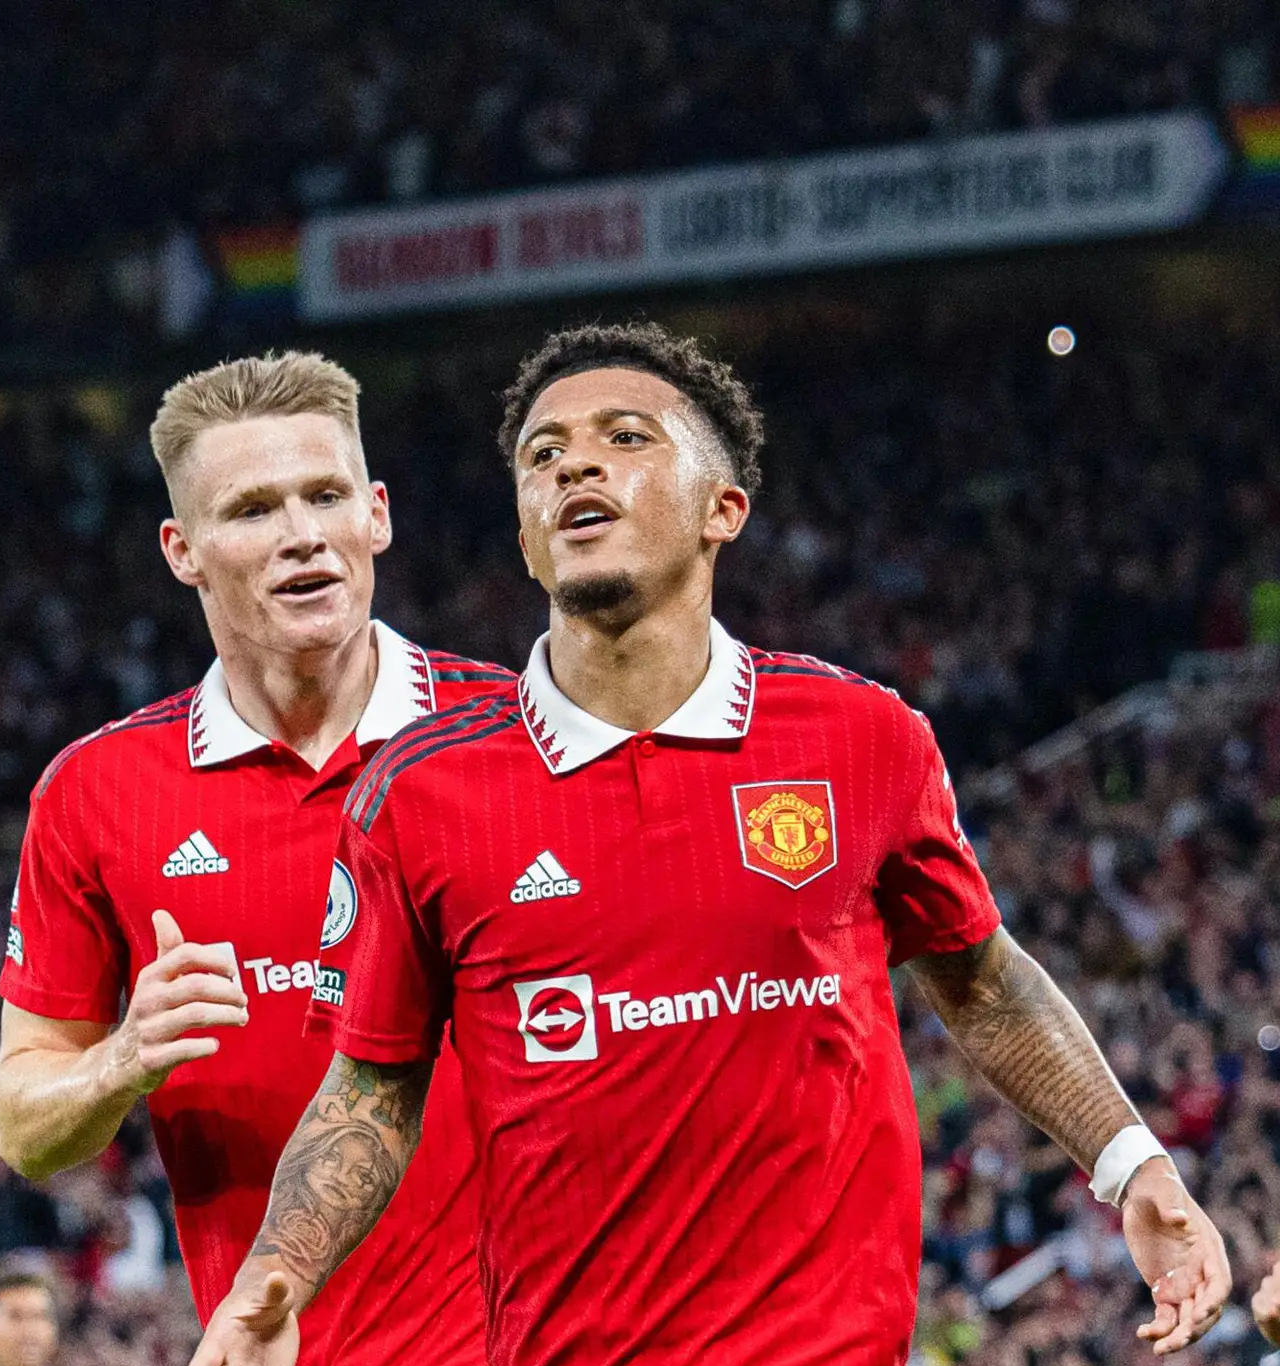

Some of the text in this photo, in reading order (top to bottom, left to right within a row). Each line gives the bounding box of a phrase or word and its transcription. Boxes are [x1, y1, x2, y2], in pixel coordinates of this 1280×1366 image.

[162, 856, 229, 878] adidas
[771, 849, 815, 865] UNITED
[510, 877, 581, 903] adidas
[598, 972, 841, 1033] TeamViewer
